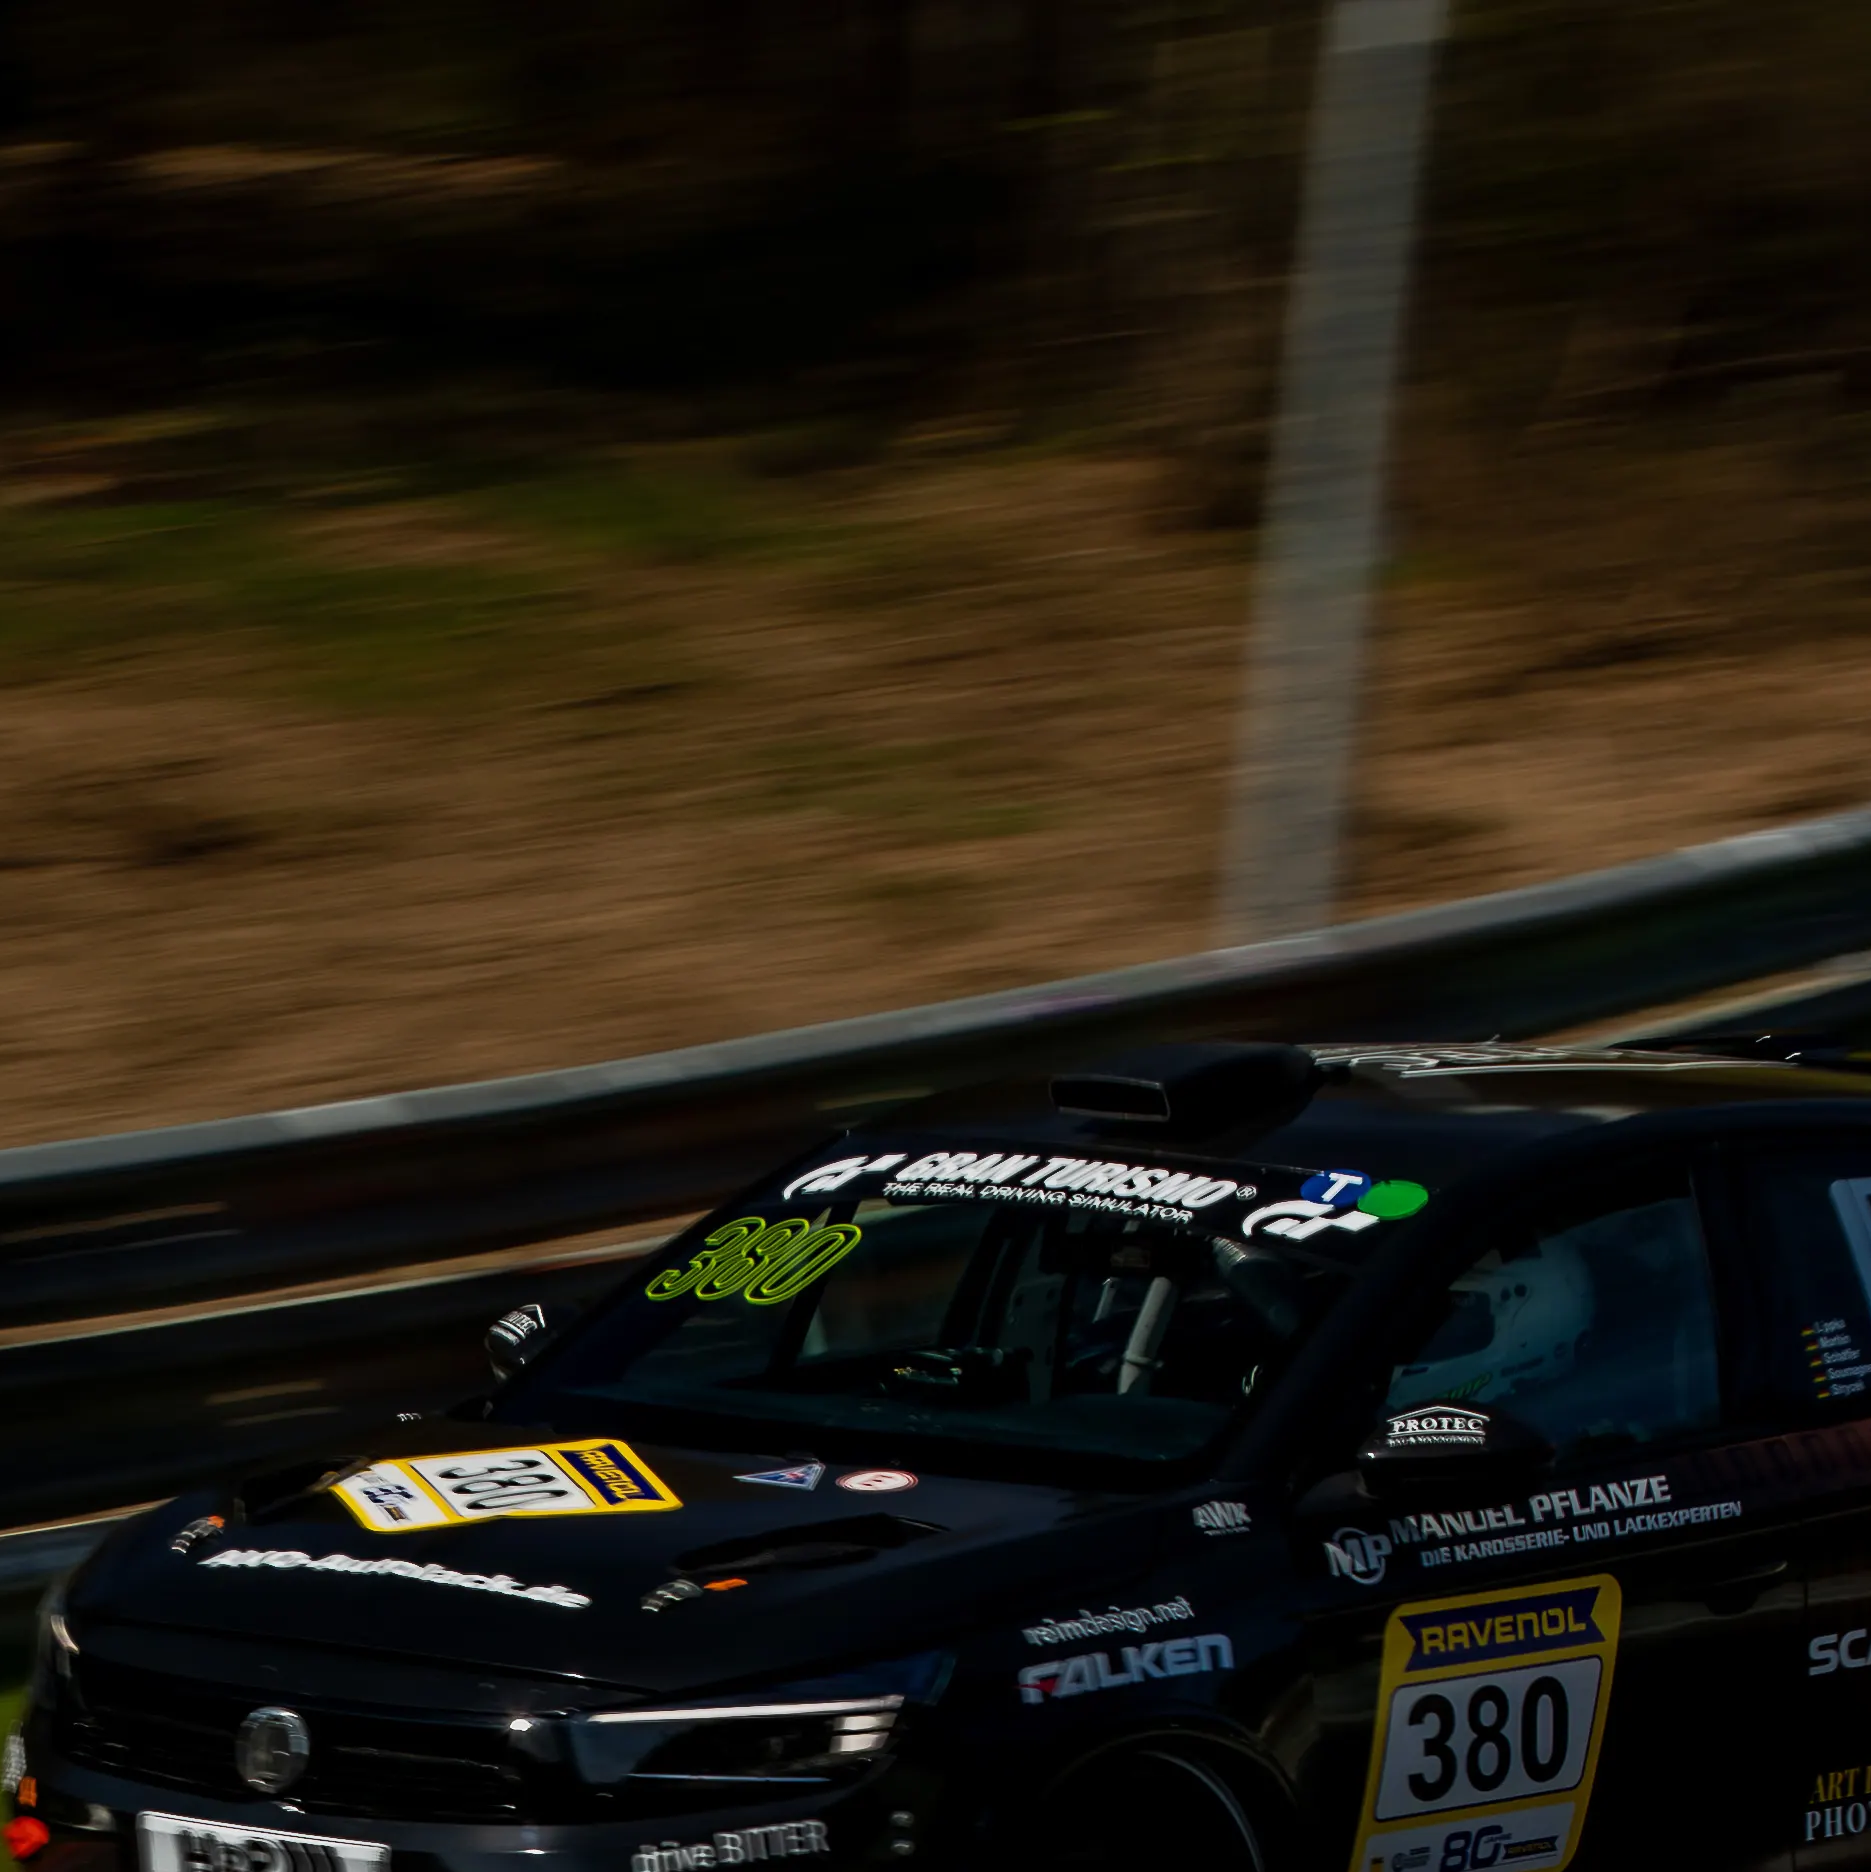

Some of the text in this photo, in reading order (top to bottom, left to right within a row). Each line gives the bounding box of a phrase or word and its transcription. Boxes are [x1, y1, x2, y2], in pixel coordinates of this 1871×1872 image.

[896, 1152, 1041, 1183] GRAN
[882, 1182, 1195, 1224] THE REAL DRIVING SIMULATOR
[644, 1216, 862, 1306] 380
[1391, 1417, 1484, 1433] PROTEC
[438, 1459, 569, 1511] 380
[1388, 1474, 1672, 1547] MANUEL PFLANZE
[1420, 1500, 1742, 1567] DIE KAROSSERIE- UND LACKEXPERTEN
[1020, 1594, 1196, 1647] reimdesign.net
[1420, 1606, 1587, 1656] RAVENOL
[1017, 1632, 1235, 1706] FALKEN
[1408, 1675, 1568, 1802] 380
[1809, 1766, 1861, 1805] ART
[713, 1818, 832, 1864] BITTER
